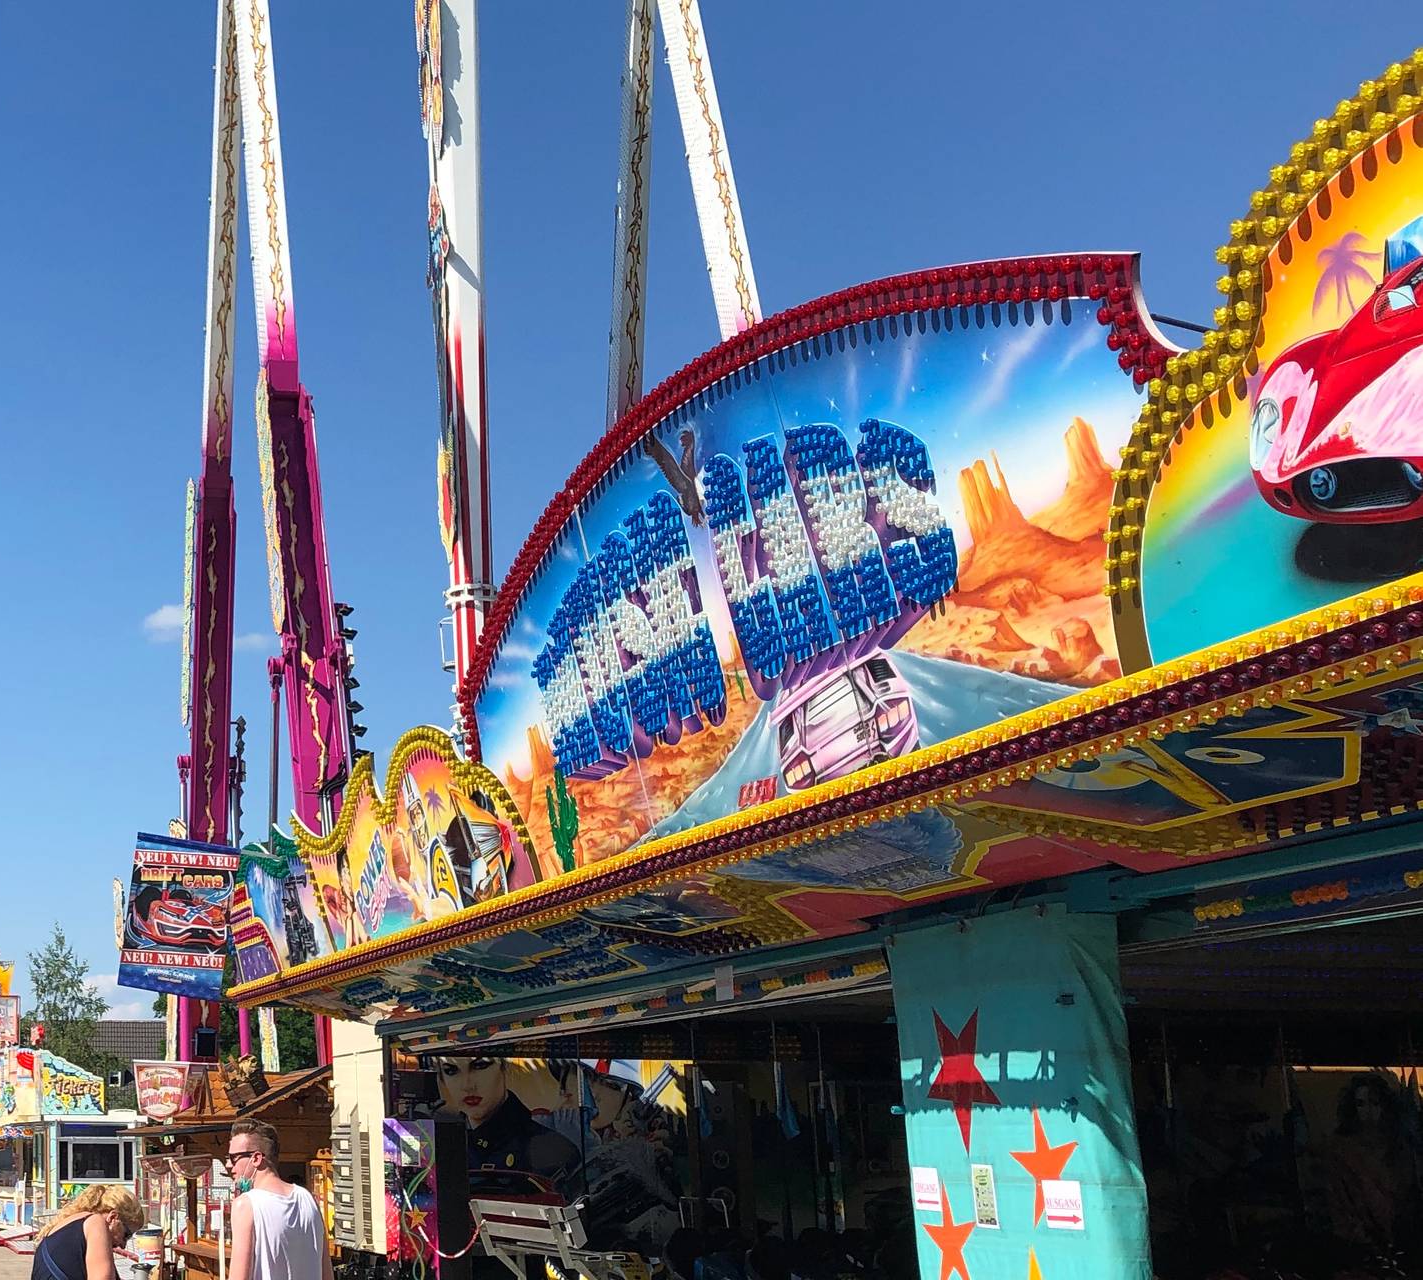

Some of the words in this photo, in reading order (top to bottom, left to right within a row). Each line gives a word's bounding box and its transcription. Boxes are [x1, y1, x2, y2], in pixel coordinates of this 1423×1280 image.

[704, 418, 959, 682] CARS
[137, 851, 167, 864] NEU!
[171, 853, 204, 866] NEW!
[206, 856, 238, 868] NEU!
[140, 867, 184, 882] DRIFT
[182, 874, 224, 888] CARS
[355, 829, 386, 923] POWER
[123, 951, 153, 963] NEU!
[157, 953, 189, 965] NEW!
[192, 955, 223, 968] NEU!
